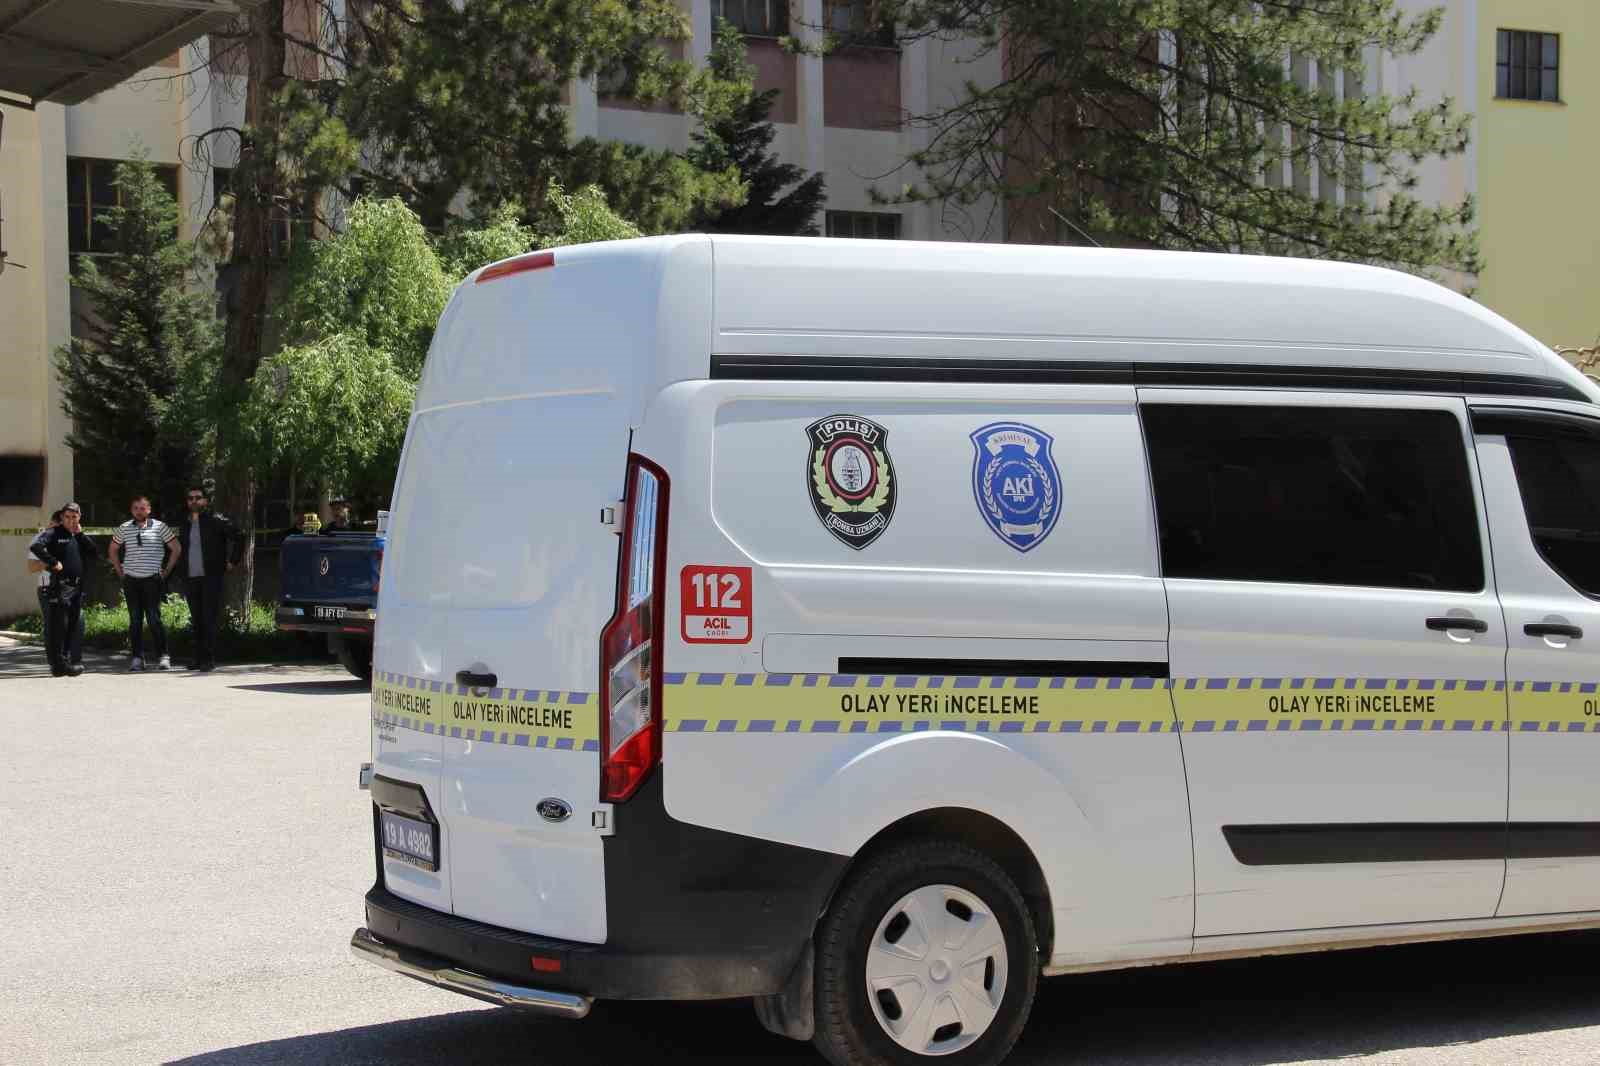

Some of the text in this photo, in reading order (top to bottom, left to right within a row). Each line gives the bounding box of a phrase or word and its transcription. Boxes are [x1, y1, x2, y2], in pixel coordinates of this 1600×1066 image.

[692, 572, 741, 608] 112
[453, 701, 478, 721] OLAY
[841, 694, 890, 712] OLAY
[1269, 695, 1310, 712] OLAY
[385, 821, 432, 857] 19 A 4982
